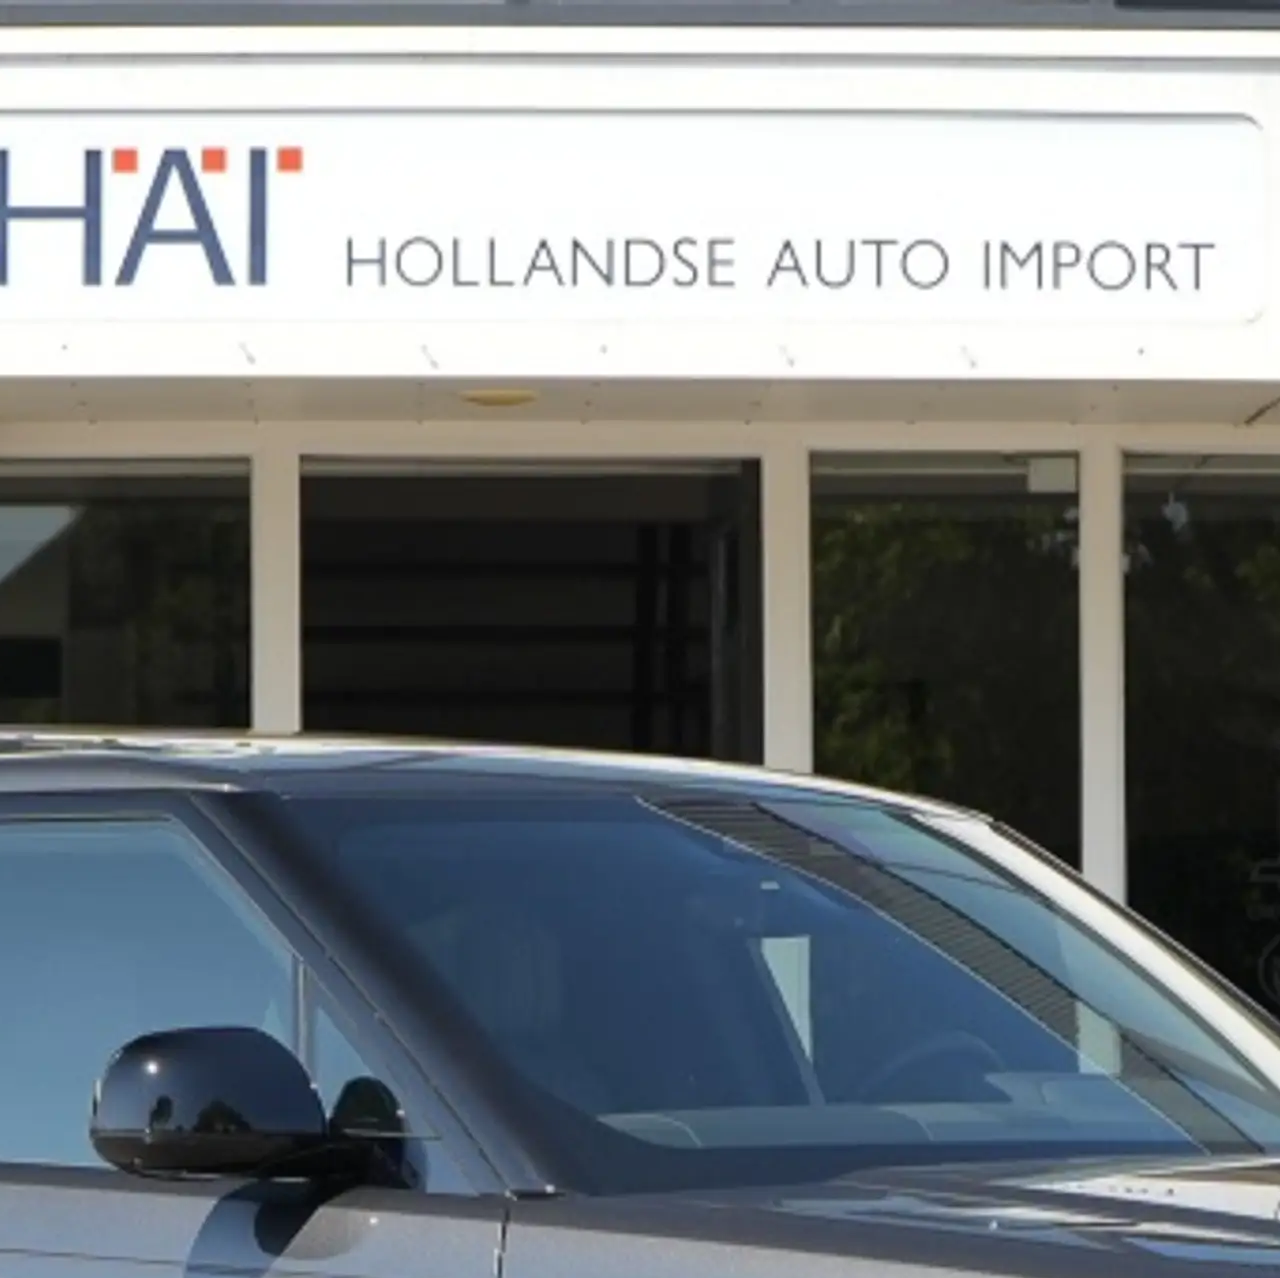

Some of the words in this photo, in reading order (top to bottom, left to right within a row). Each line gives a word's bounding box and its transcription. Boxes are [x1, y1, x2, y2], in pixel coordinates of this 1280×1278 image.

[346, 236, 735, 287] HOLLANDSE
[767, 239, 949, 290] AUTO
[984, 240, 1215, 290] IMPORT
